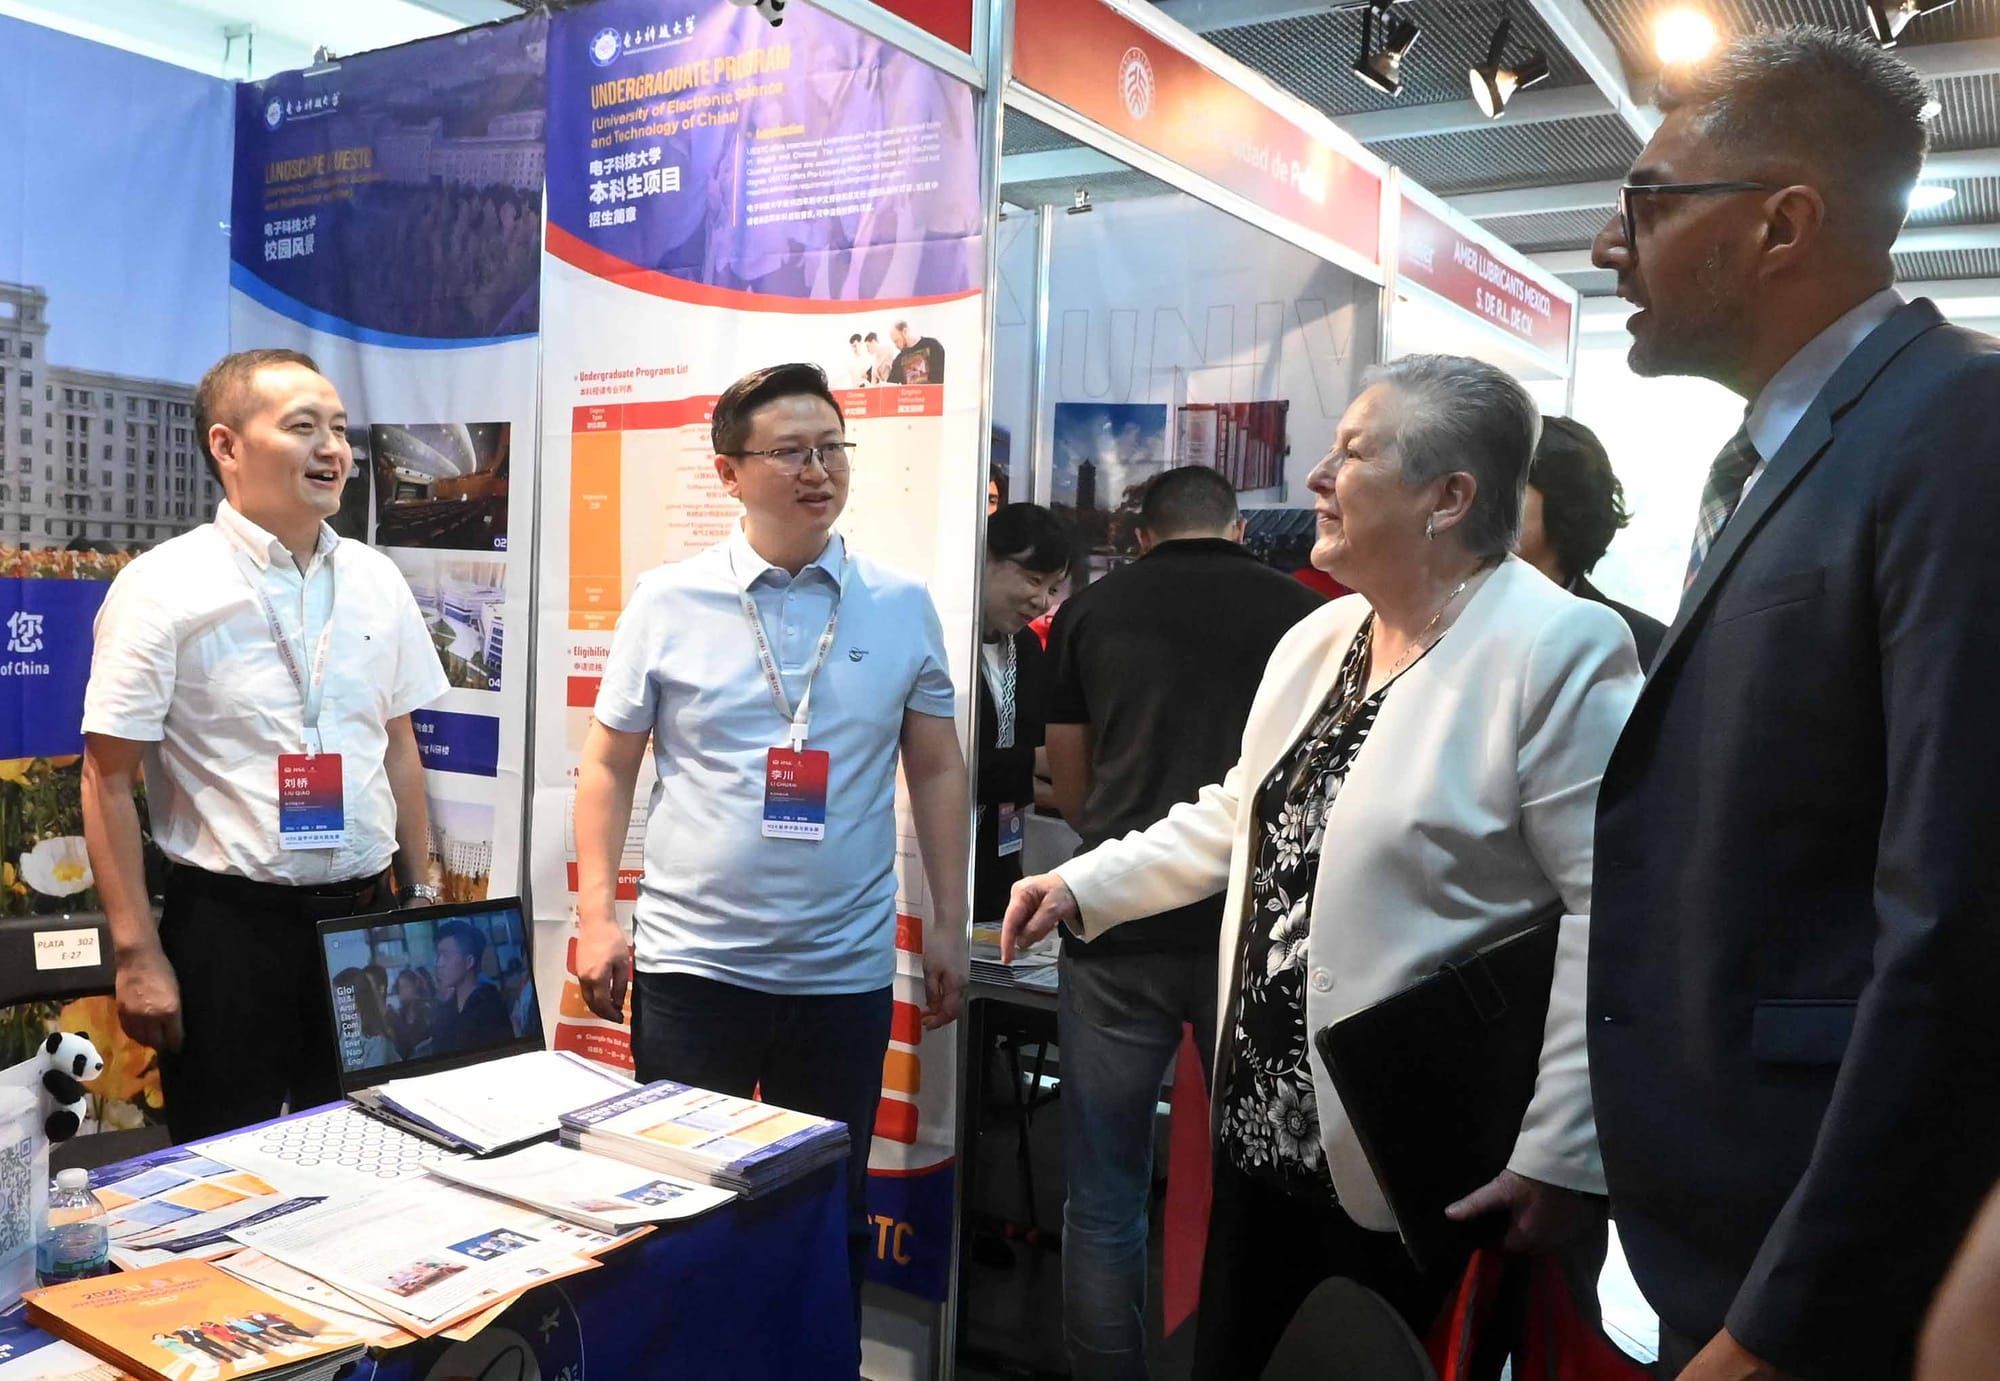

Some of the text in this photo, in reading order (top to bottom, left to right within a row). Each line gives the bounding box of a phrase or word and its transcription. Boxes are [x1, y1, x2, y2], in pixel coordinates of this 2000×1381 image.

[591, 61, 711, 110] UNDERGRADUATE
[714, 42, 791, 85] PROGRAM
[591, 81, 784, 134] (University of Electronic Science
[591, 108, 739, 148] and Technology of China)
[589, 146, 662, 176] 电子科技大学
[1271, 151, 1288, 182] de
[589, 166, 680, 205] 本科生项目
[263, 214, 317, 237] 电子科技大学
[588, 206, 637, 229] 招生简章
[264, 233, 315, 262] 校园风景
[1454, 240, 1478, 273] AMER
[1478, 254, 1525, 302] LUBRICANTS
[1485, 293, 1496, 317] DE
[580, 364, 689, 382] Undergraduate Programs List
[494, 538, 507, 548] 02
[6, 611, 44, 653] 您
[573, 646, 610, 658] Eligibility
[0, 661, 50, 677] of China
[488, 678, 501, 688] 04
[284, 777, 309, 789] 刘桥
[771, 769, 794, 781] 李川
[618, 873, 642, 885] erio
[37, 938, 94, 949] PLATA 302
[61, 951, 82, 960] E-27
[867, 1214, 914, 1265] TC
